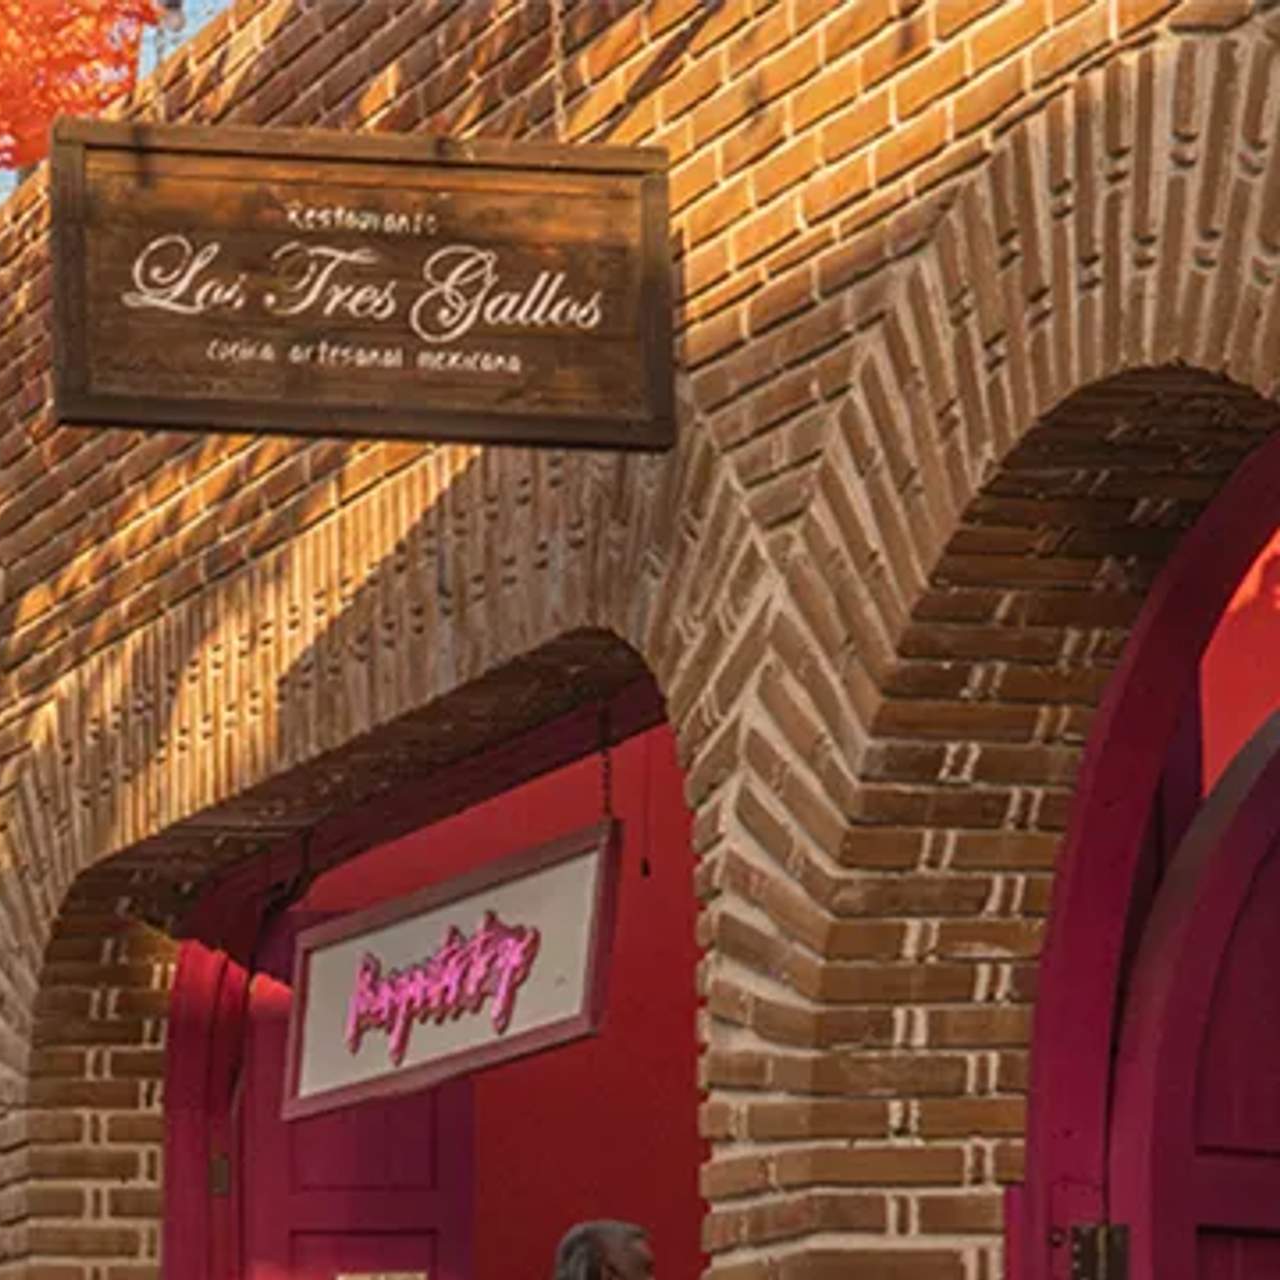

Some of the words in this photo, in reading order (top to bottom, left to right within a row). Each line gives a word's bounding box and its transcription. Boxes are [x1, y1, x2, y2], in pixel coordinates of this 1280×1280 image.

[121, 234, 247, 314] Los
[264, 241, 398, 319] Tres
[410, 244, 603, 343] Gallos
